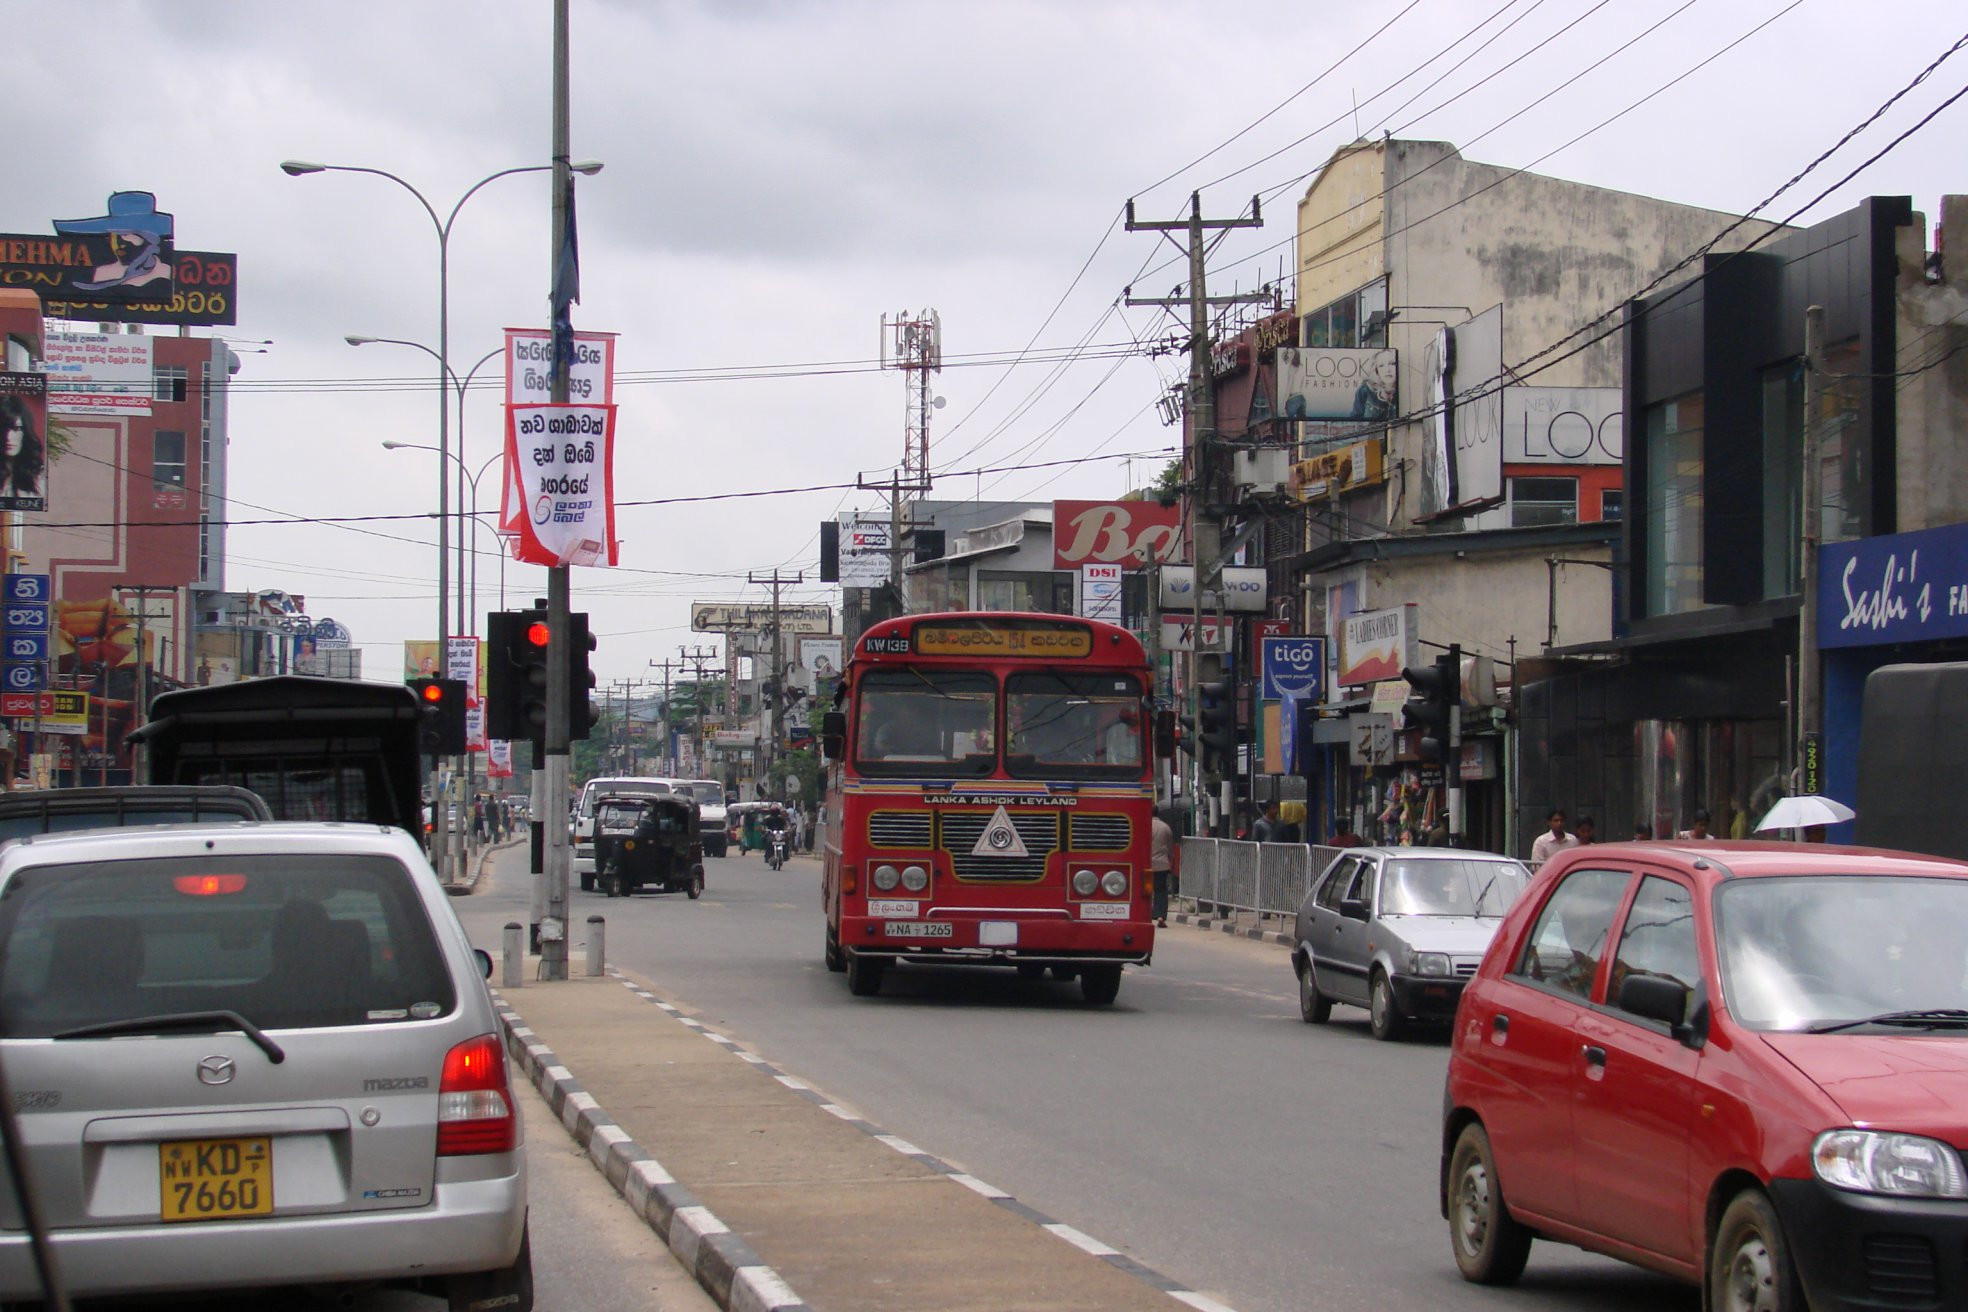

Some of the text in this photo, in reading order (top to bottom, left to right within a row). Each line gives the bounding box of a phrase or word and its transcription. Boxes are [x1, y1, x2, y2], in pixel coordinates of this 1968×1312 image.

[1304, 357, 1371, 378] LOOK
[1304, 380, 1359, 389] FASHION
[864, 536, 887, 545] DFCC
[1057, 505, 1182, 562] Ba
[1089, 568, 1117, 578] DSI
[1840, 549, 1932, 630] Sashi's
[924, 795, 1077, 807] LANKA ASHOK LEYLAND
[924, 925, 951, 936] 1265
[197, 1143, 241, 1176] KD
[174, 1178, 258, 1214] 7660
